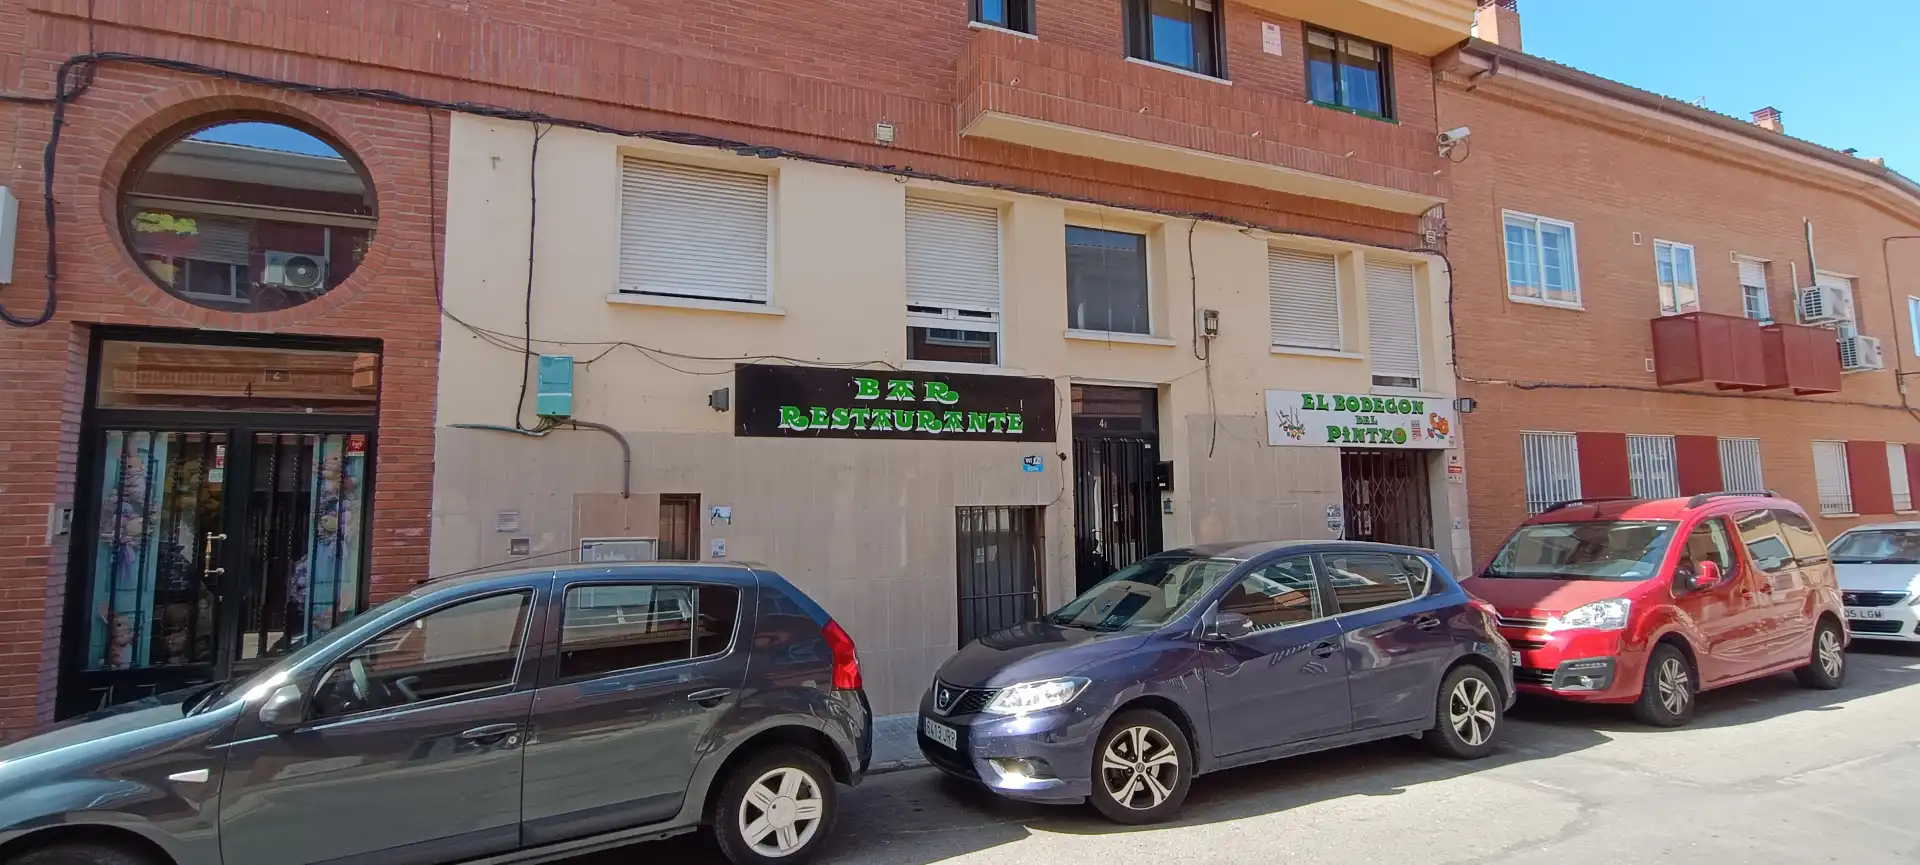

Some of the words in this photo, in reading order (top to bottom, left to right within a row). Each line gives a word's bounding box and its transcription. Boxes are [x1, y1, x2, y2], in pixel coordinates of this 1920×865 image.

[244, 381, 254, 397] 4
[854, 377, 960, 405] BAR
[1301, 393, 1329, 411] EL
[1333, 394, 1424, 415] BODEGON
[777, 405, 1024, 434] RESTAURANTE
[1355, 415, 1378, 426] DEL
